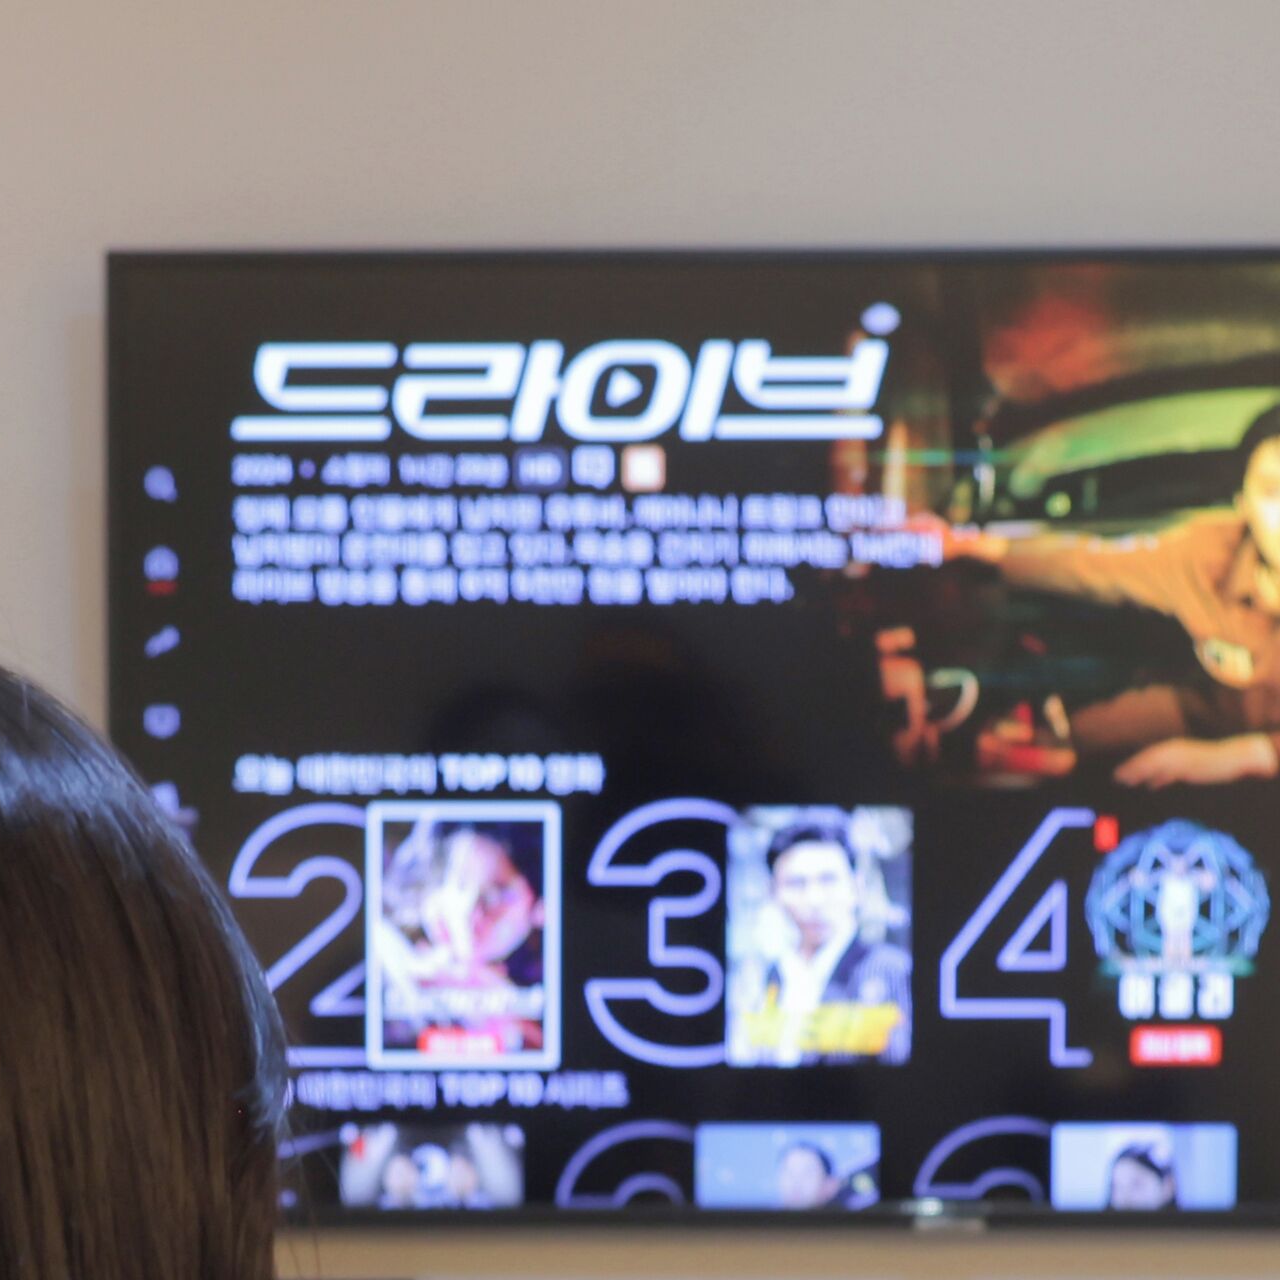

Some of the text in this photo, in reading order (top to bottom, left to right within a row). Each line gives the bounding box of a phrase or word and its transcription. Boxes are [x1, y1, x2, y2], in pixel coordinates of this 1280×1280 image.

[230, 303, 900, 442] 드라이브
[583, 797, 728, 1068] 3
[939, 806, 1096, 1068] 4
